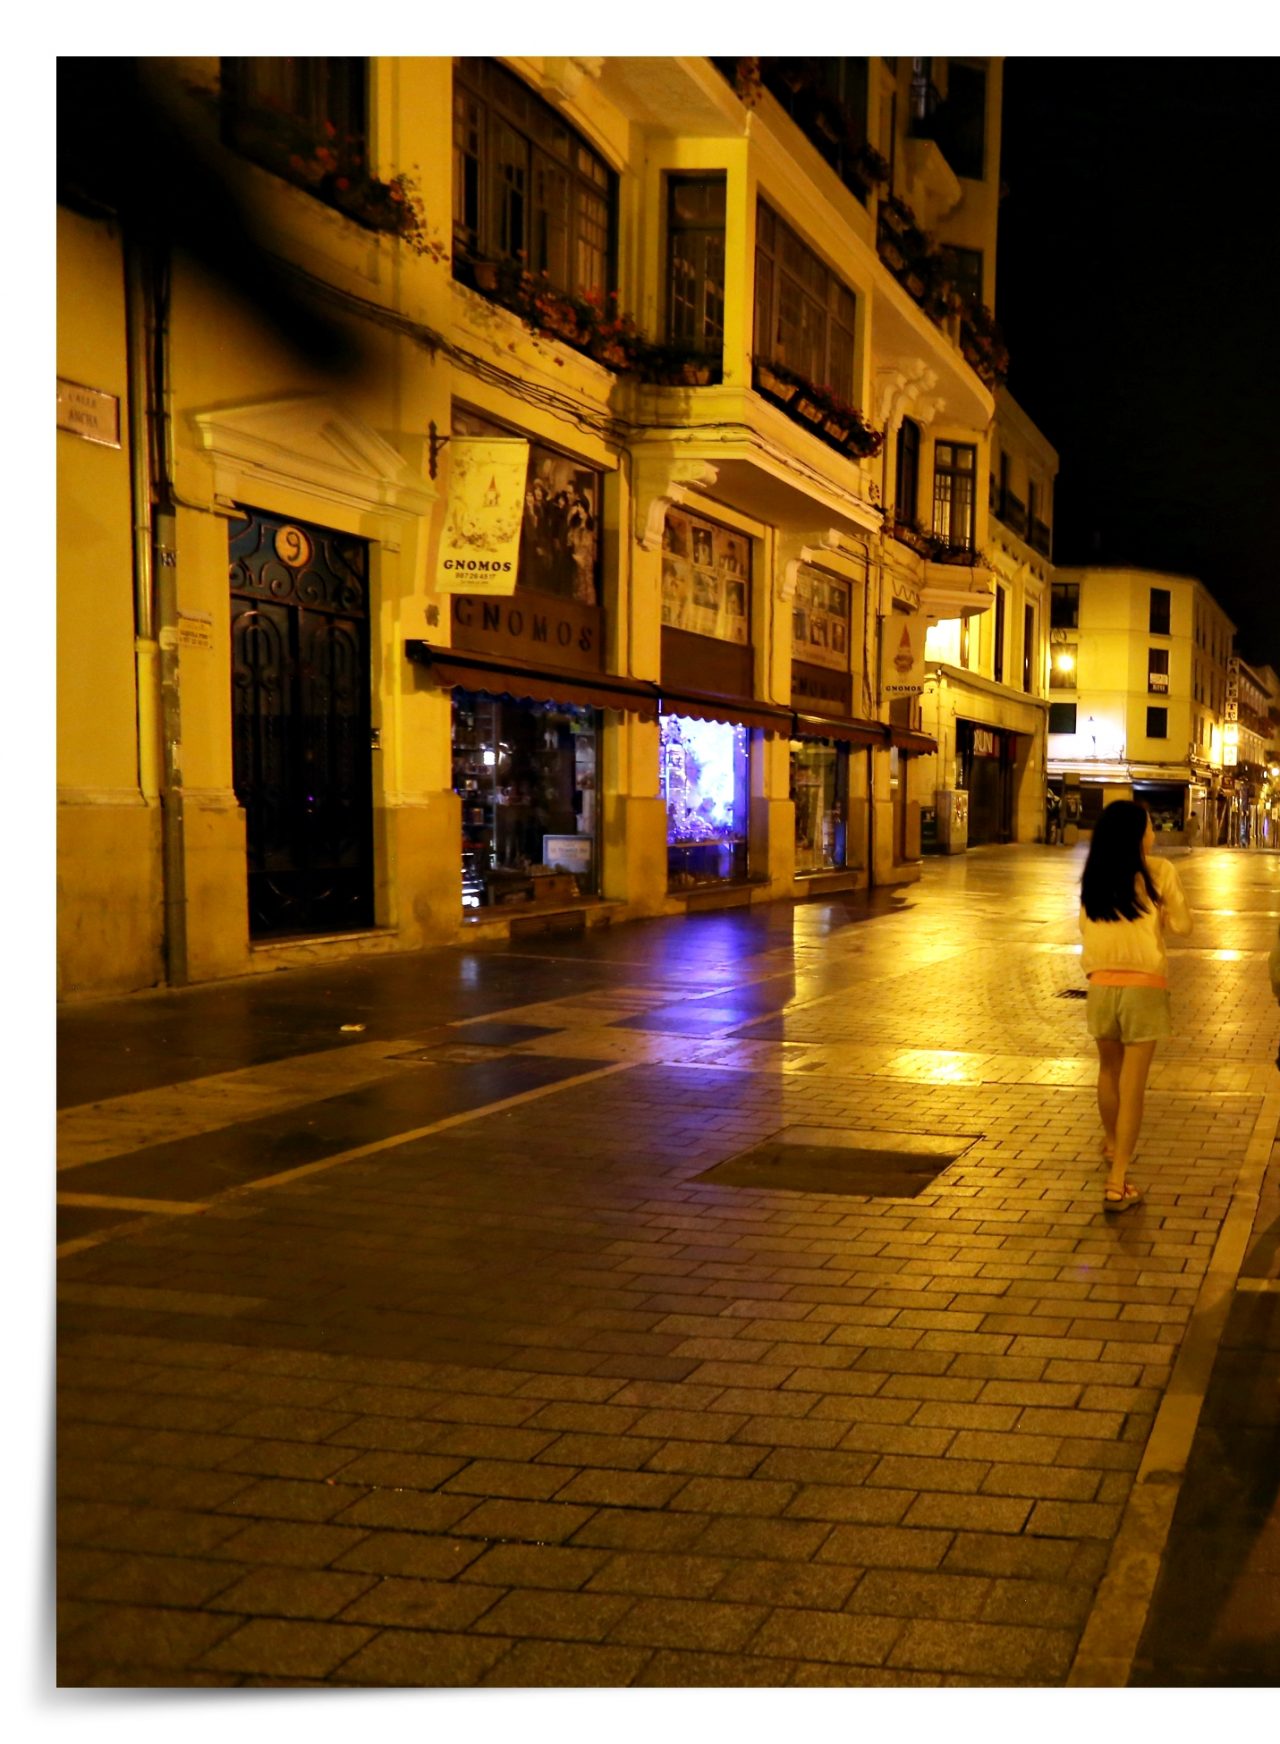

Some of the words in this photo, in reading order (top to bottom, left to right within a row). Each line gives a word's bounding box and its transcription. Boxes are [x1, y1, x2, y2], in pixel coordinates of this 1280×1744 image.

[286, 531, 301, 562] 9
[443, 559, 512, 572] GNOMOS
[454, 597, 593, 652] GNOMOS
[885, 684, 922, 692] GNOMOS
